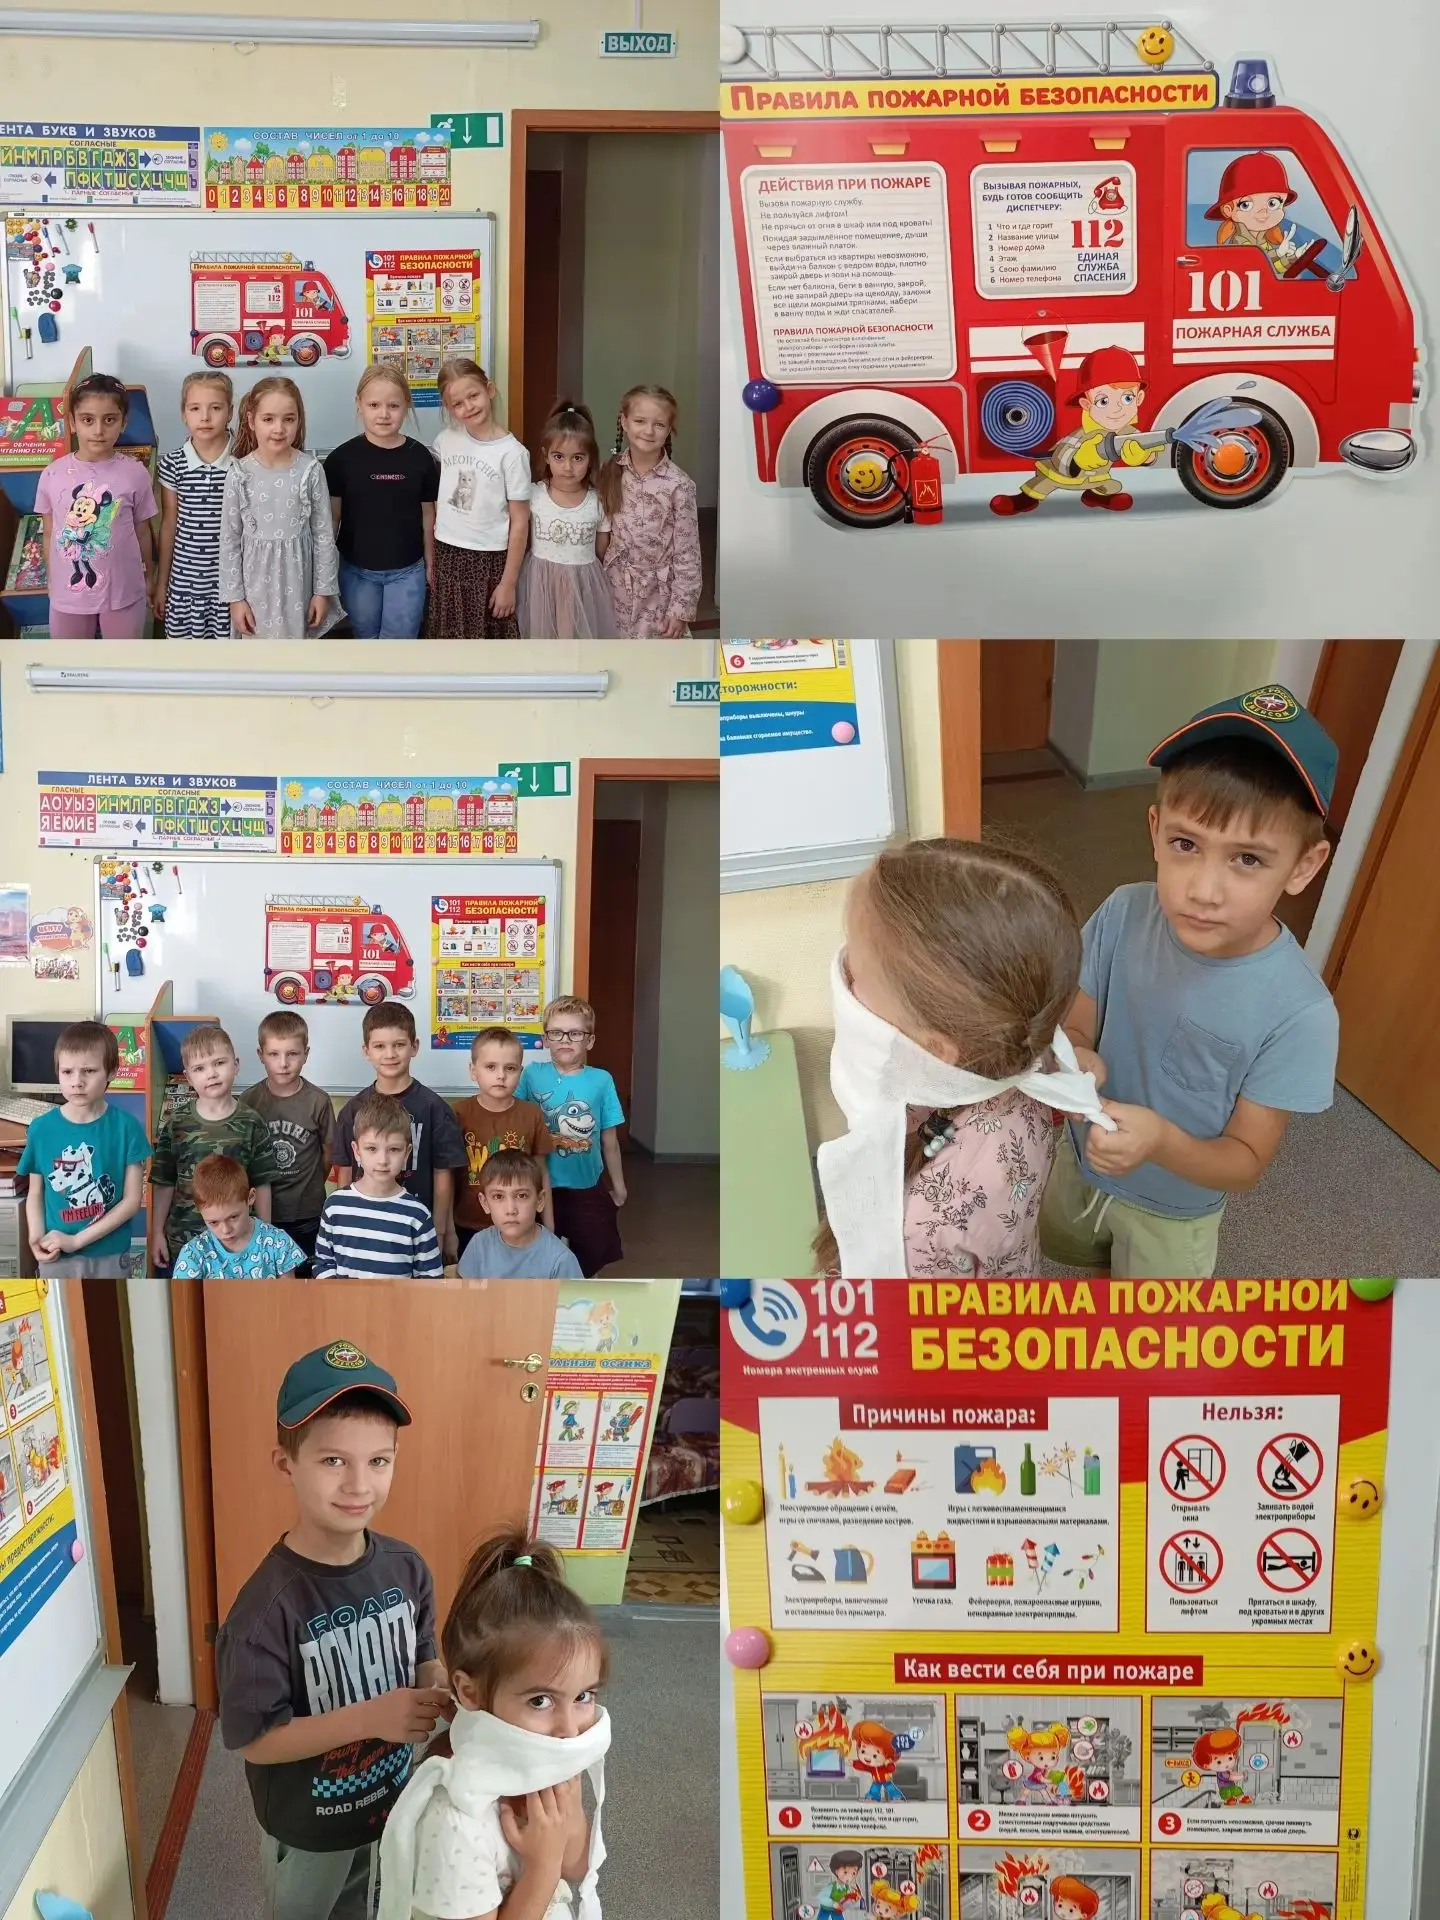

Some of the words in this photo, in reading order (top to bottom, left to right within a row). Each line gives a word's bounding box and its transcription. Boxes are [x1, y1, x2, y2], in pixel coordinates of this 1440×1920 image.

[607, 35, 669, 52] ВЫХОД
[730, 85, 859, 112] ПРАВИЛА
[867, 82, 1010, 109] ПОЖАРНОЙ
[1019, 83, 1209, 106] БЕЗОПАСНОСТИ
[42, 125, 77, 137] БУКВ
[85, 127, 96, 137] И
[103, 127, 157, 138] ЗВУКОВ
[253, 132, 299, 140] СОСТАВ
[305, 132, 343, 141] ЧИСЕЛ
[388, 132, 400, 140] 10
[69, 139, 117, 148] СОГЛАСНЫЕ
[758, 177, 834, 195] ДЕЙСТВИЯ
[837, 178, 867, 190] ПРИ
[871, 176, 931, 190] ПОЖАРЕ
[983, 182, 1026, 190] ВЫЗЫВАЯ
[1028, 181, 1081, 190] ПОЖАРНЫХ,
[209, 189, 216, 202] 0
[232, 189, 239, 202] 2
[255, 189, 262, 202] 4
[278, 189, 285, 202] 6
[301, 189, 308, 202] 8
[322, 189, 333, 202] 10
[345, 189, 356, 202] 12
[369, 189, 380, 202] 14
[392, 189, 403, 202] 16
[416, 189, 427, 202] 18
[439, 189, 450, 202] 20
[982, 194, 1004, 202] БУДЬ
[1034, 192, 1083, 202] СООБЩИТЬ
[1006, 203, 1063, 213] ДИСПЕТЧЕРУ:
[760, 211, 771, 219] Не
[1071, 219, 1124, 249] 112
[1025, 244, 1045, 252] дома
[384, 254, 395, 262] 101
[1077, 252, 1119, 263] ЕДИНАЯ
[400, 261, 473, 270] БЕЗОПАСНОСТИ
[1077, 262, 1120, 273] СЛУЖБА
[990, 276, 995, 284] 6
[999, 276, 1025, 284] Номер
[1073, 272, 1126, 283] СПАСЕНИЯ
[1188, 269, 1263, 312] 101
[268, 294, 281, 302] 112
[295, 307, 313, 318] 101
[773, 327, 814, 336] ПРАВИЛА
[815, 325, 866, 335] ПОЖАРНОЙ
[867, 323, 934, 333] БЕЗОПАСНОСТИ
[1176, 325, 1262, 340] ПОЖАРНАЯ
[1266, 324, 1331, 338] СЛУЖБА
[679, 684, 720, 700] ВЫХ
[87, 775, 127, 786] ЛЕНТА
[134, 776, 166, 787] БУКВ
[172, 777, 182, 787] И
[188, 777, 237, 788] ЗВУКОВ
[51, 786, 85, 794] ГЛАСНЫЕ
[158, 788, 201, 796] СОГЛАСНЫЕ
[337, 936, 349, 944] 112
[362, 949, 381, 959] 101
[811, 1279, 875, 1316] 101
[907, 1281, 1097, 1316] ПРАВИЛА
[812, 1321, 879, 1359] 112
[910, 1324, 1345, 1371] БЕЗОПАСНОСТИ
[743, 1364, 783, 1376] Номера
[785, 1365, 846, 1376] экстренных
[847, 1364, 880, 1377] служб
[852, 1402, 946, 1427] Причины
[952, 1407, 1036, 1427] пожара:
[1201, 1402, 1284, 1421] Нельзя:
[1291, 1501, 1315, 1512] водой
[1182, 1514, 1199, 1522] окна
[1169, 1597, 1218, 1606] Пользоваться
[903, 1658, 942, 1679] Как
[948, 1663, 1006, 1679] вести
[1012, 1659, 1060, 1680] себя
[1067, 1664, 1107, 1684] при
[1113, 1664, 1195, 1685] пожаре
[316, 1802, 353, 1816] ROAD
[355, 1785, 390, 1810] REBEL
[785, 1809, 794, 1825] 1
[974, 1812, 985, 1828] 2
[1165, 1816, 1176, 1831] 3
